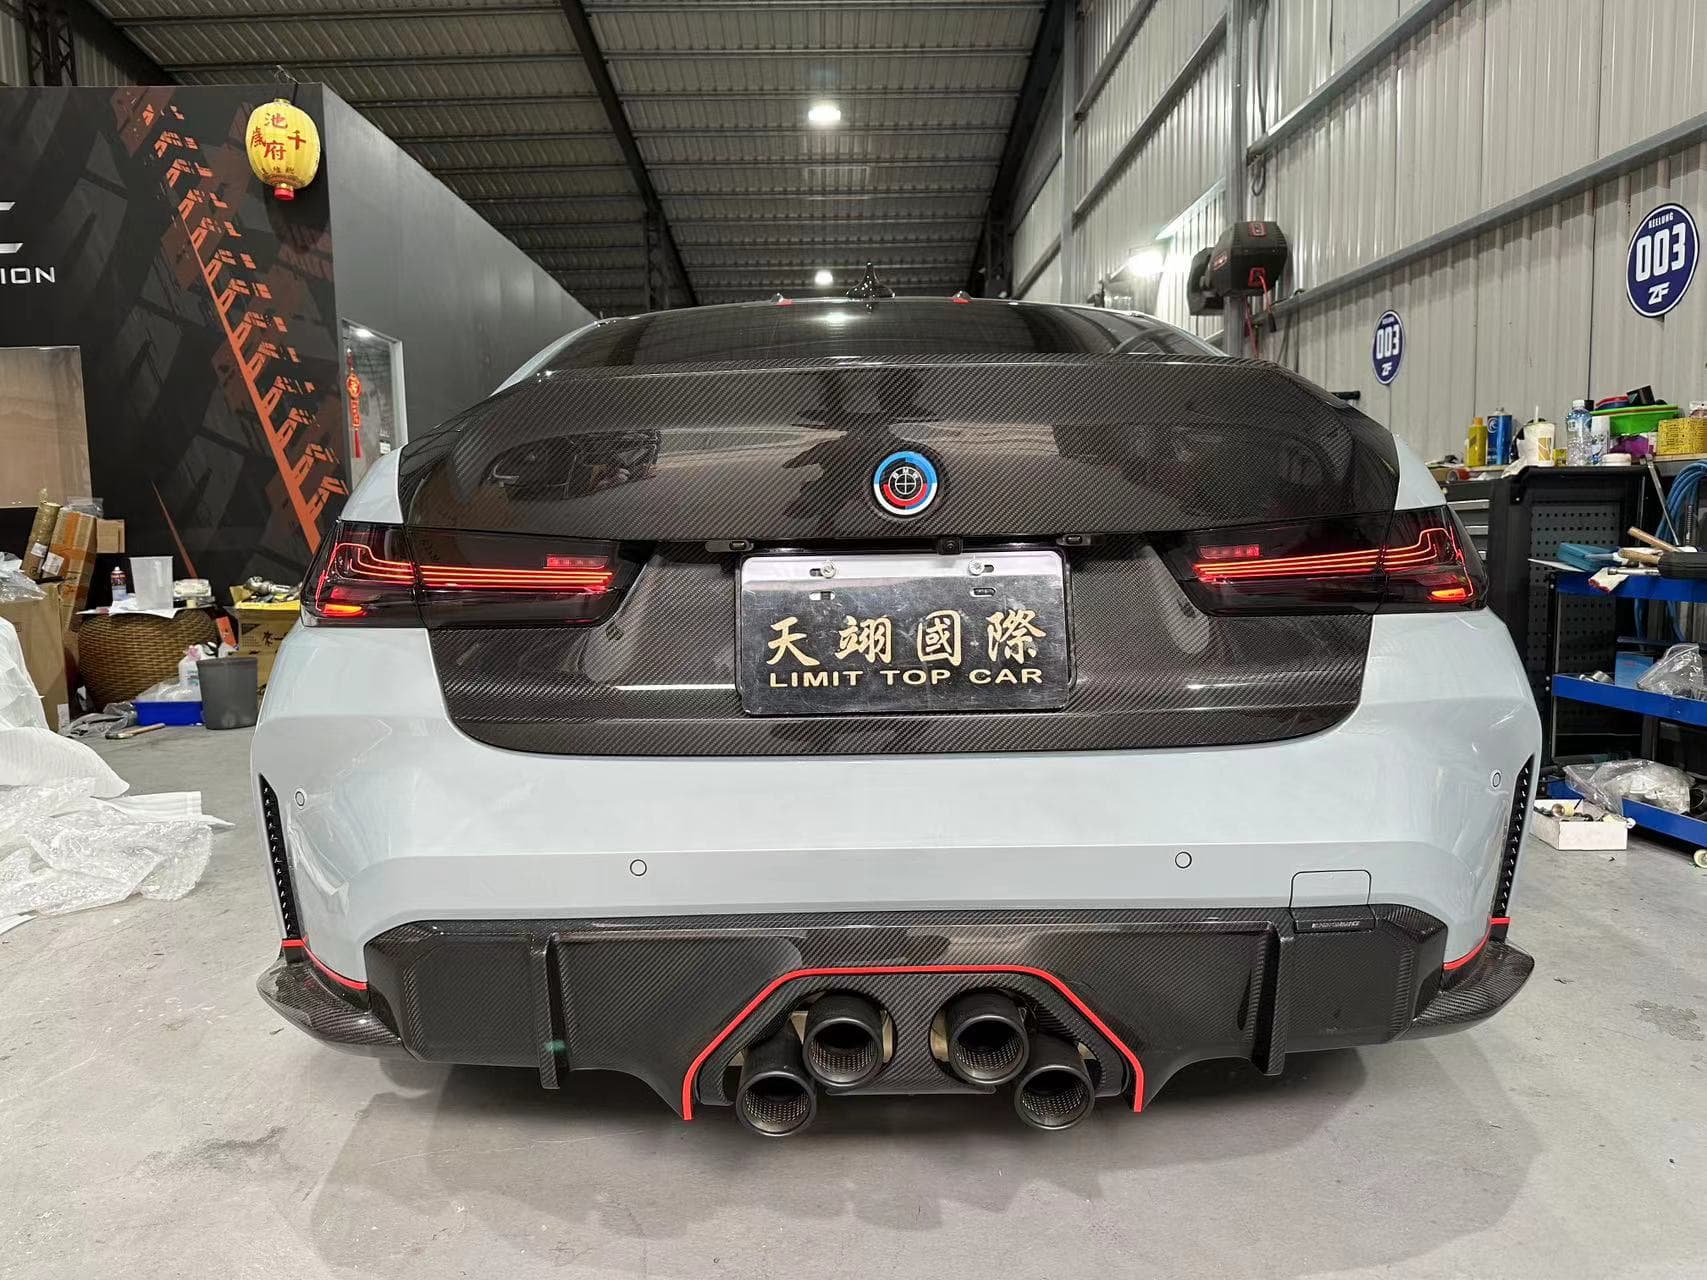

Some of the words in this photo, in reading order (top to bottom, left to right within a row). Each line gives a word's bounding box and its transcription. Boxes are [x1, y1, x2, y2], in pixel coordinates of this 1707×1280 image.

[1635, 222, 1686, 282] 003
[1648, 281, 1671, 305] ZF
[1376, 324, 1400, 360] 003
[766, 609, 1047, 667] 天翊國際
[769, 670, 864, 688] LIMIT
[880, 668, 951, 686] TOP
[968, 668, 1043, 685] CAR
